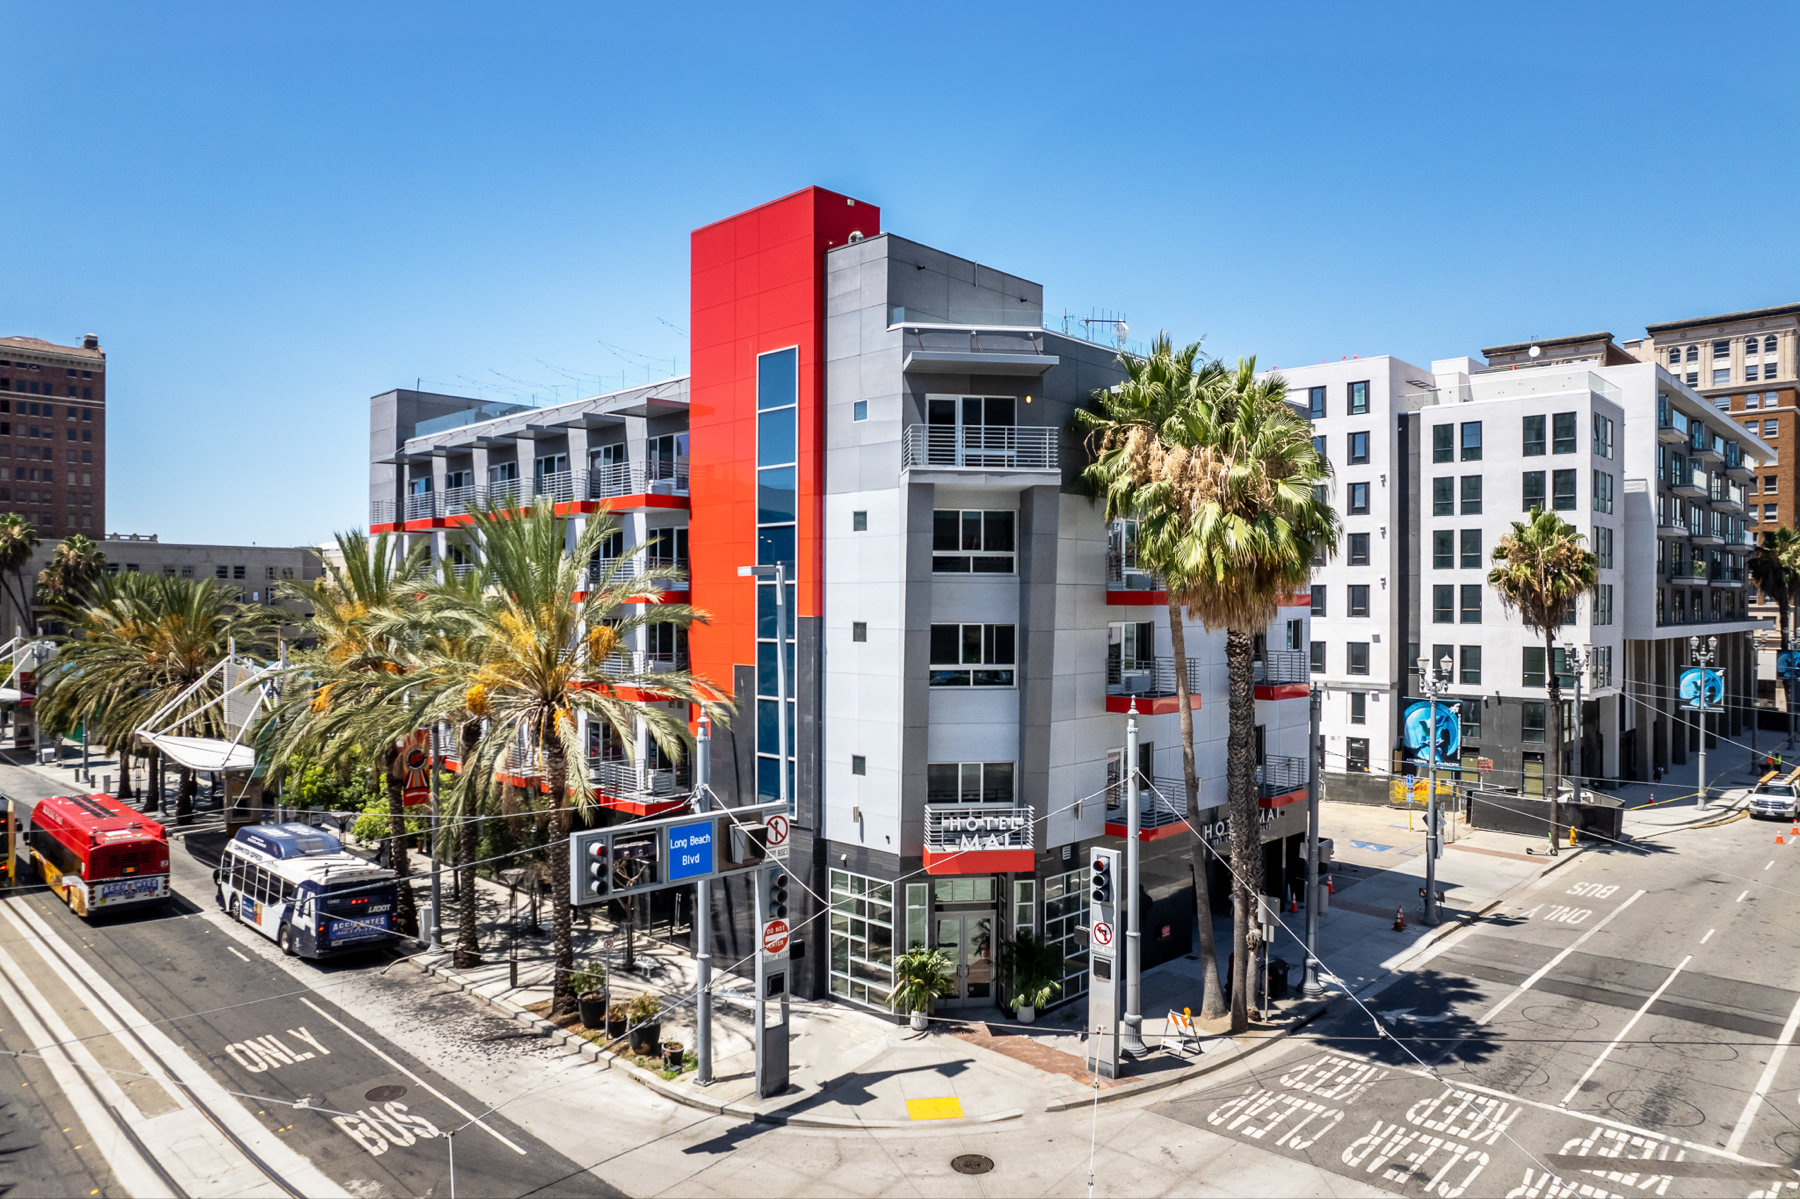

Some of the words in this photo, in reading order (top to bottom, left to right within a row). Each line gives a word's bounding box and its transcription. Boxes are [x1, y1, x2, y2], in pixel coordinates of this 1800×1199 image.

[949, 817, 1018, 831] HOTEL
[670, 838, 688, 849] Long
[690, 834, 711, 845] Beach
[959, 833, 1011, 850] MAI
[682, 853, 700, 866] Blvd
[777, 848, 788, 856] BUSES
[103, 880, 157, 894] ACCIENTES
[1566, 882, 1620, 899] BUS
[367, 904, 391, 913] LADOT
[1519, 903, 1593, 925] ONLY
[332, 917, 385, 931] ACCIENTES
[225, 1026, 331, 1073] ONLY
[1280, 1055, 1390, 1104] KEEP
[1207, 1086, 1345, 1150] CLEAR
[1405, 1088, 1523, 1145] KEEP
[332, 1100, 440, 1156] BUS
[1341, 1121, 1490, 1199] CLEAR
